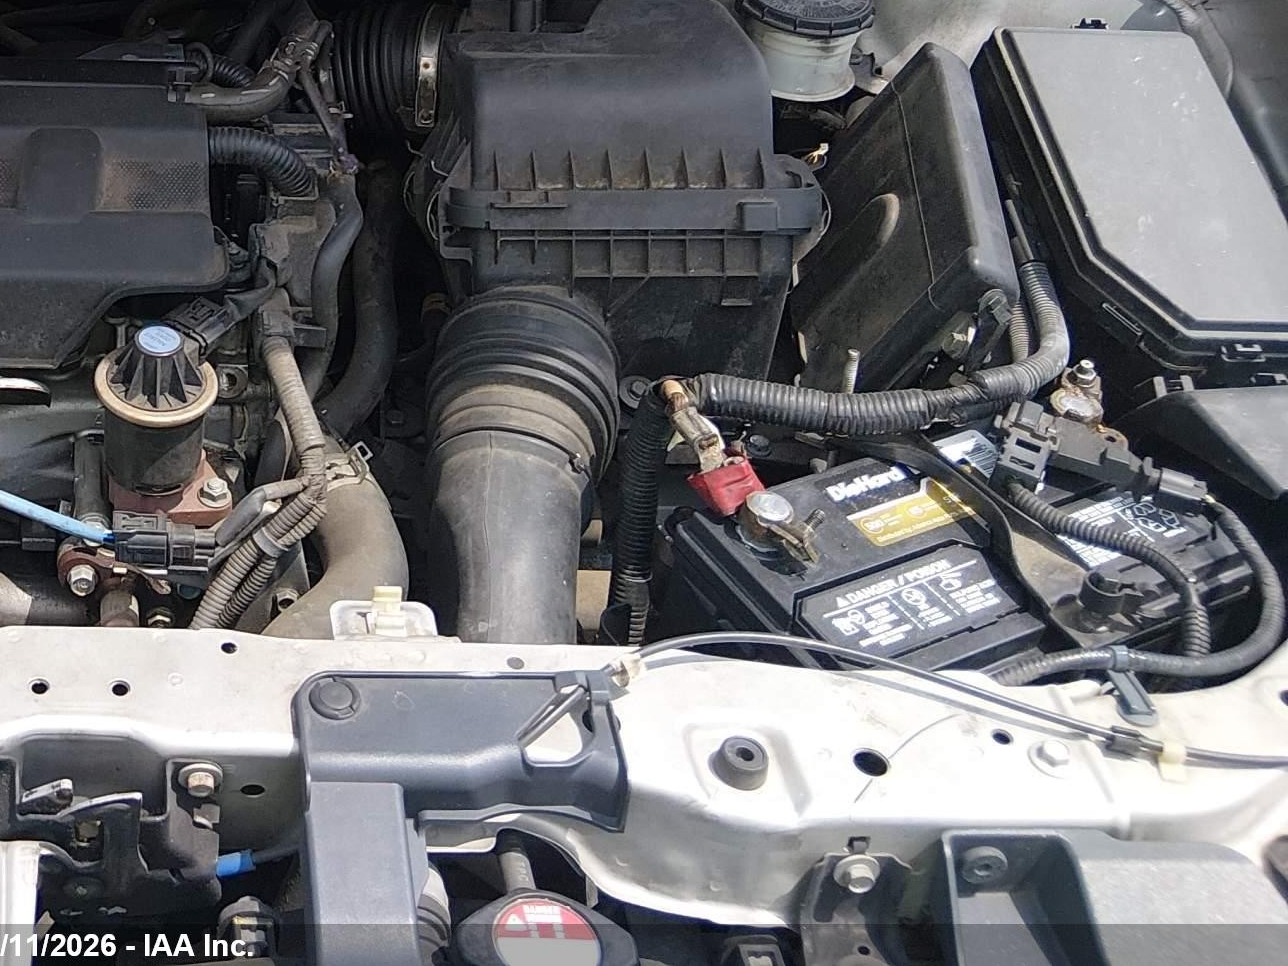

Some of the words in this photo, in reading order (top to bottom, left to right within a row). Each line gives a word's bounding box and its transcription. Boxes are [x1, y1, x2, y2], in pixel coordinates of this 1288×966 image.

[825, 466, 908, 502] DieHard
[845, 577, 898, 603] DANGER
[903, 559, 952, 584] POISON
